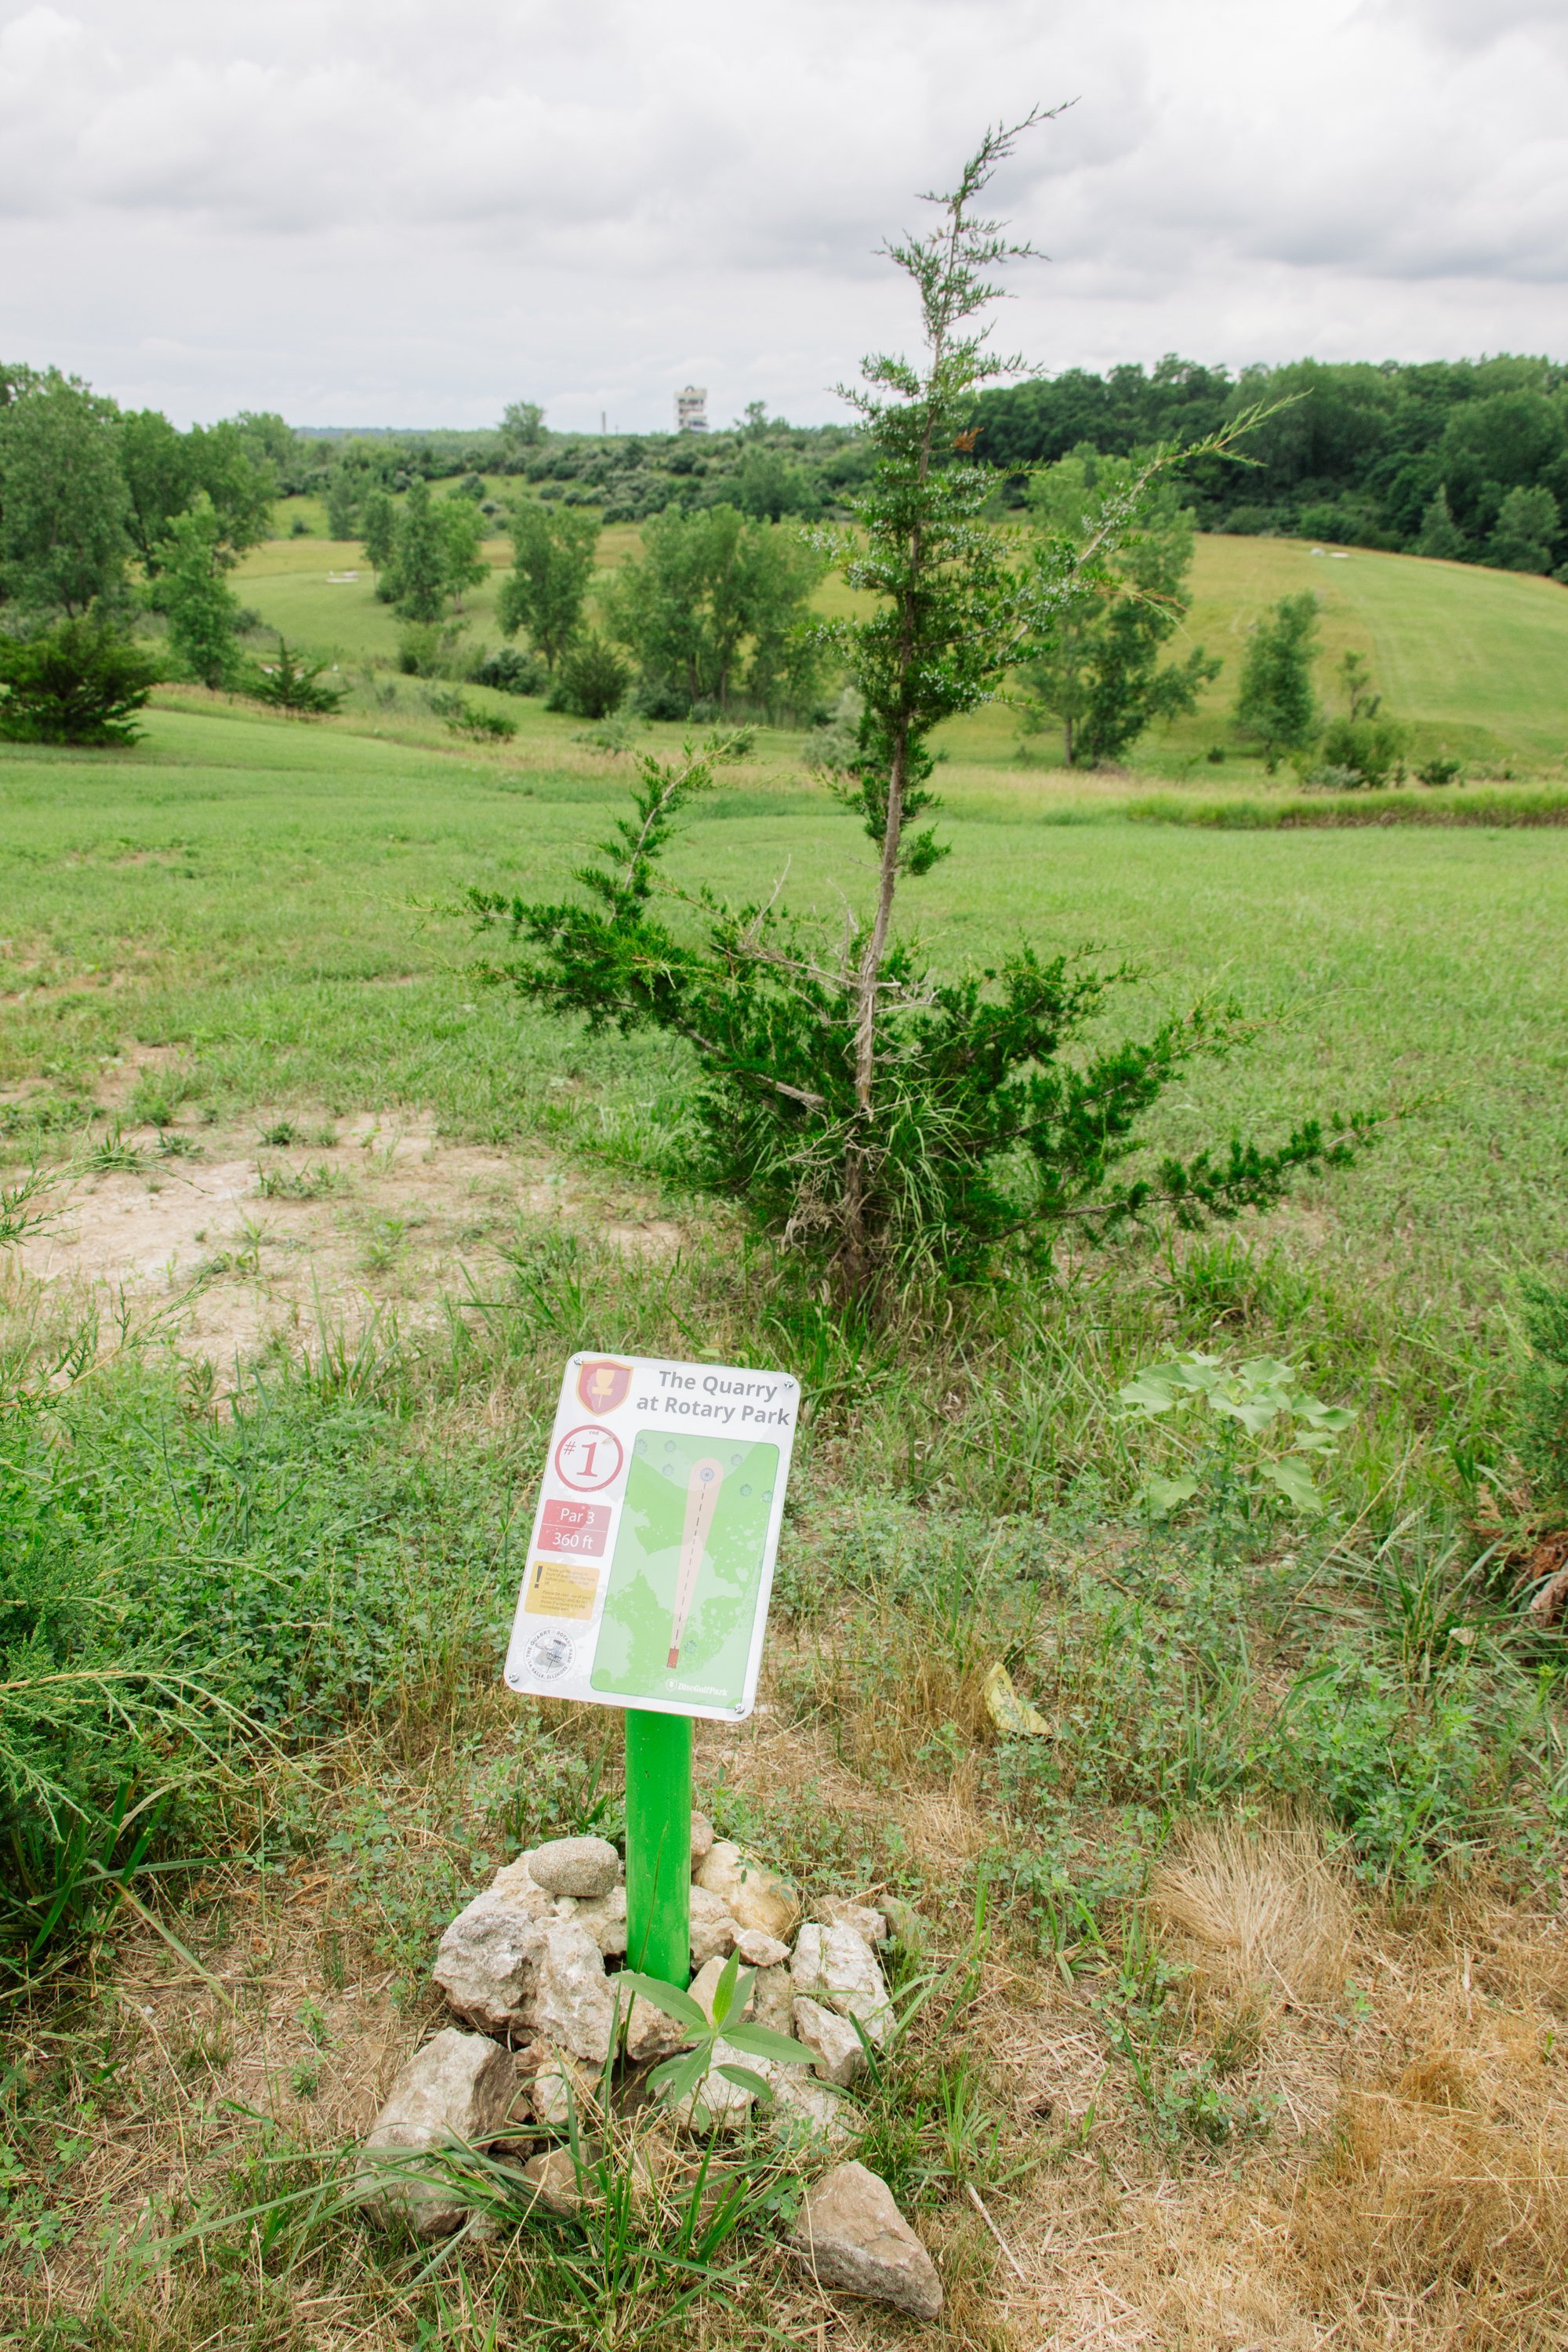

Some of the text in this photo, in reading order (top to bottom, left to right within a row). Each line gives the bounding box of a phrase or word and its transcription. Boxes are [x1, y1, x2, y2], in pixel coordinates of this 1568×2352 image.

[659, 1370, 778, 1403] The Quarry
[637, 1396, 791, 1426] at Rotary Park
[560, 1508, 595, 1524] Par 3
[552, 1532, 593, 1549] 360 ft
[530, 1629, 551, 1646] QUARRY
[556, 1631, 572, 1647] ROTARY
[677, 1682, 728, 1697] DiscGolfPark
